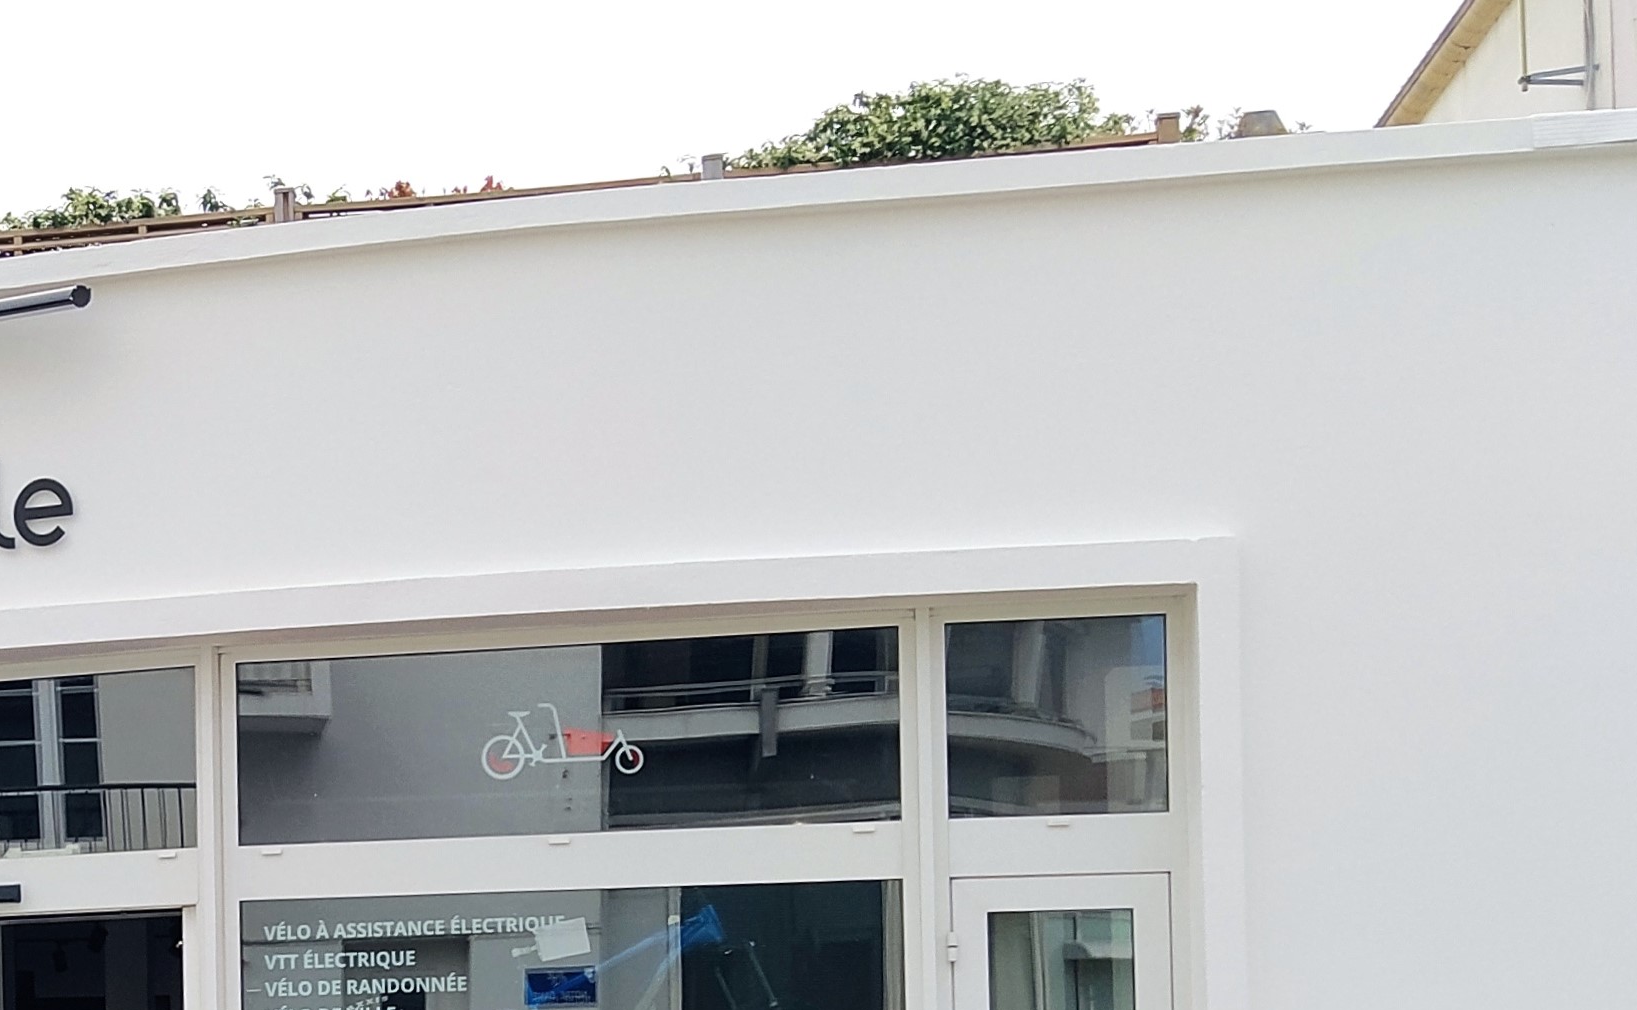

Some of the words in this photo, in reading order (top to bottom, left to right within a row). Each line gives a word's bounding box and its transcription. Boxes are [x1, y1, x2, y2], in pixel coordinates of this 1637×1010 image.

[264, 922, 311, 941] VÉLO
[316, 918, 330, 939] À
[333, 919, 445, 939] ASSISTANCE
[264, 953, 299, 970] VTT
[303, 950, 417, 969] ÉLECTRIQUE
[265, 978, 312, 997] VÉLO
[317, 981, 342, 996] DE
[346, 972, 467, 995] RANDONNÉE
